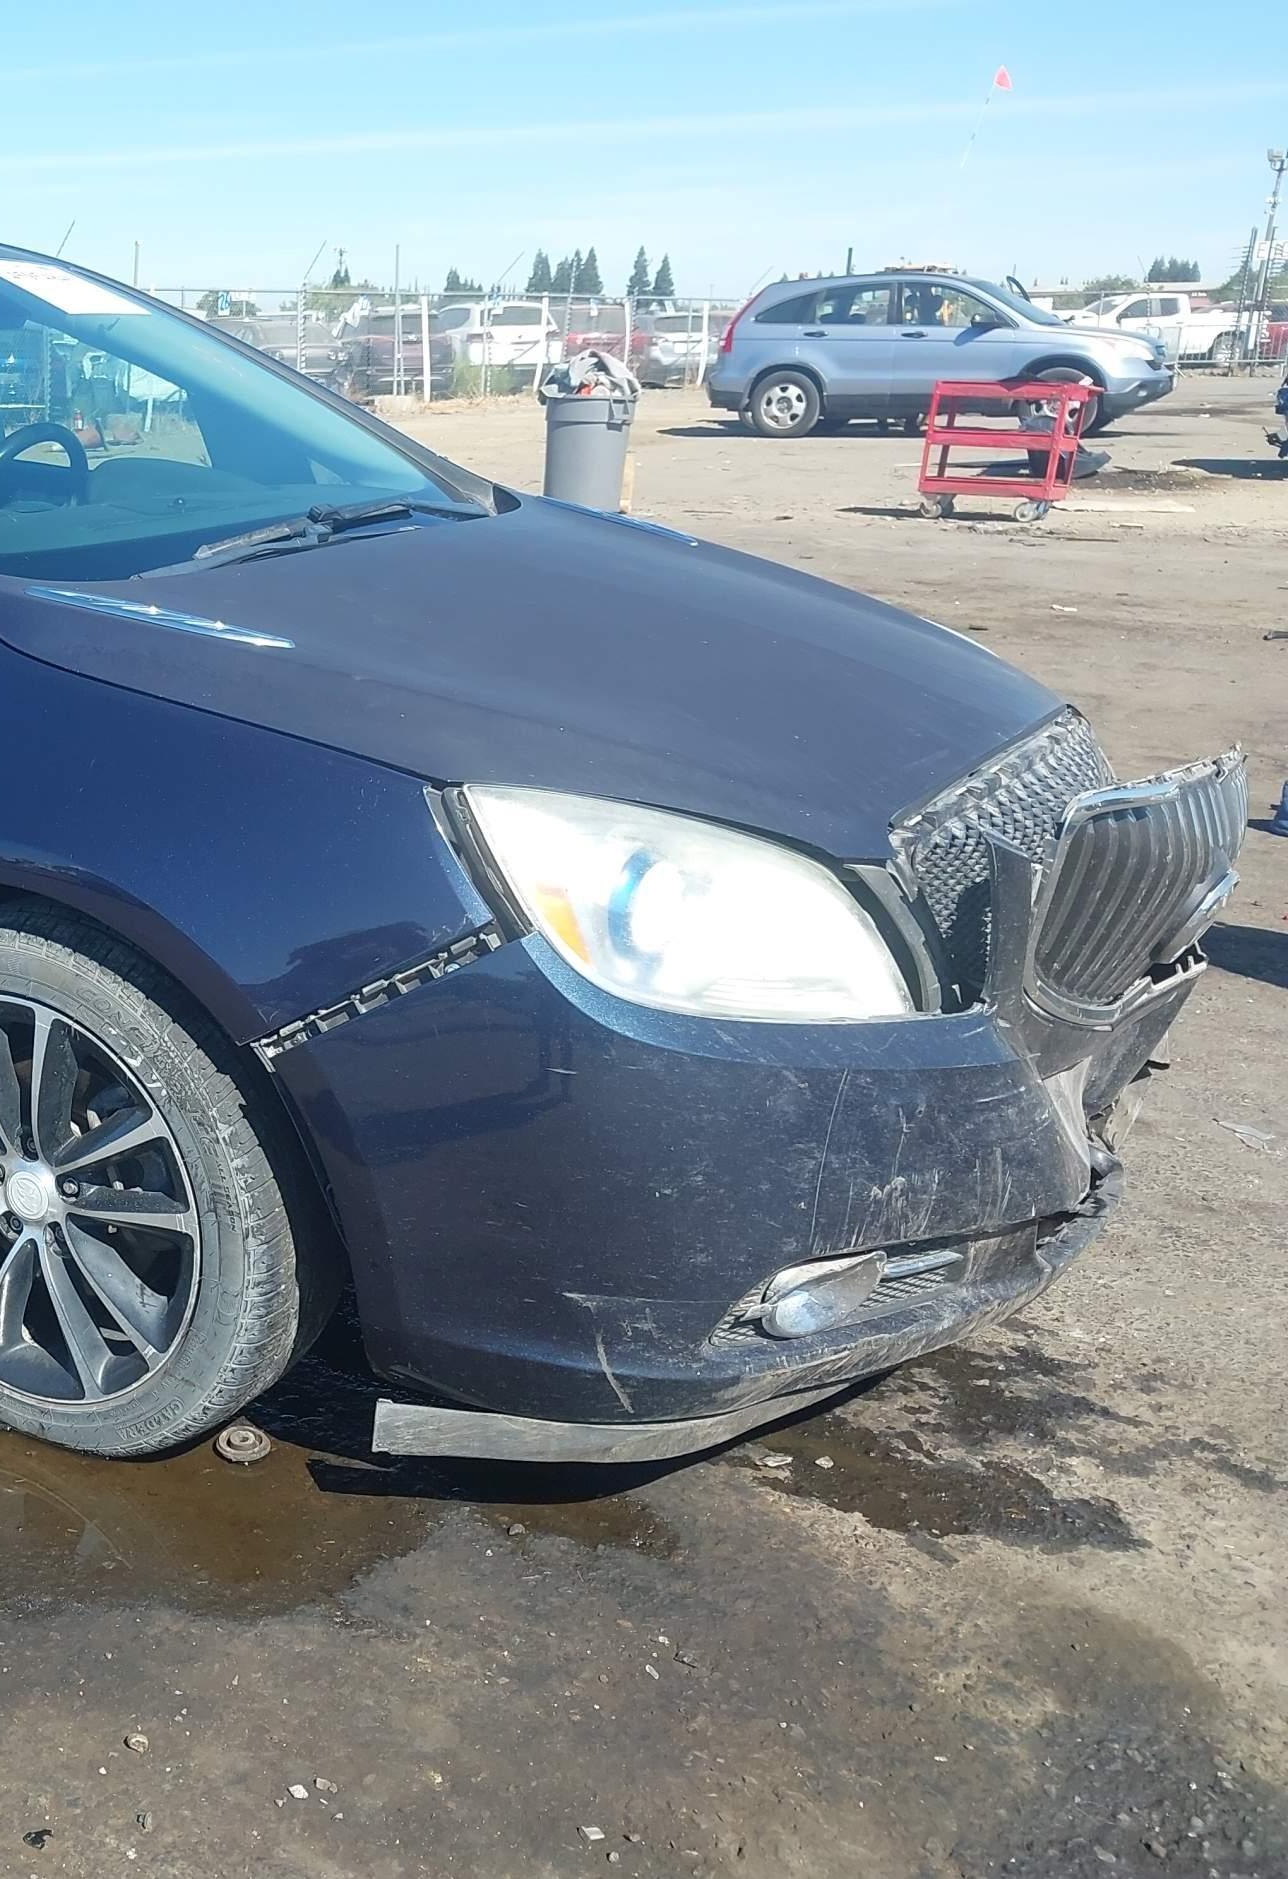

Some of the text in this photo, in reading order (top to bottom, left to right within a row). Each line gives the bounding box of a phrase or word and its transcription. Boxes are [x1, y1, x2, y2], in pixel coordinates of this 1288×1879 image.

[214, 1159, 238, 1233] ALL SEASON
[116, 1398, 185, 1441] CALDERA
